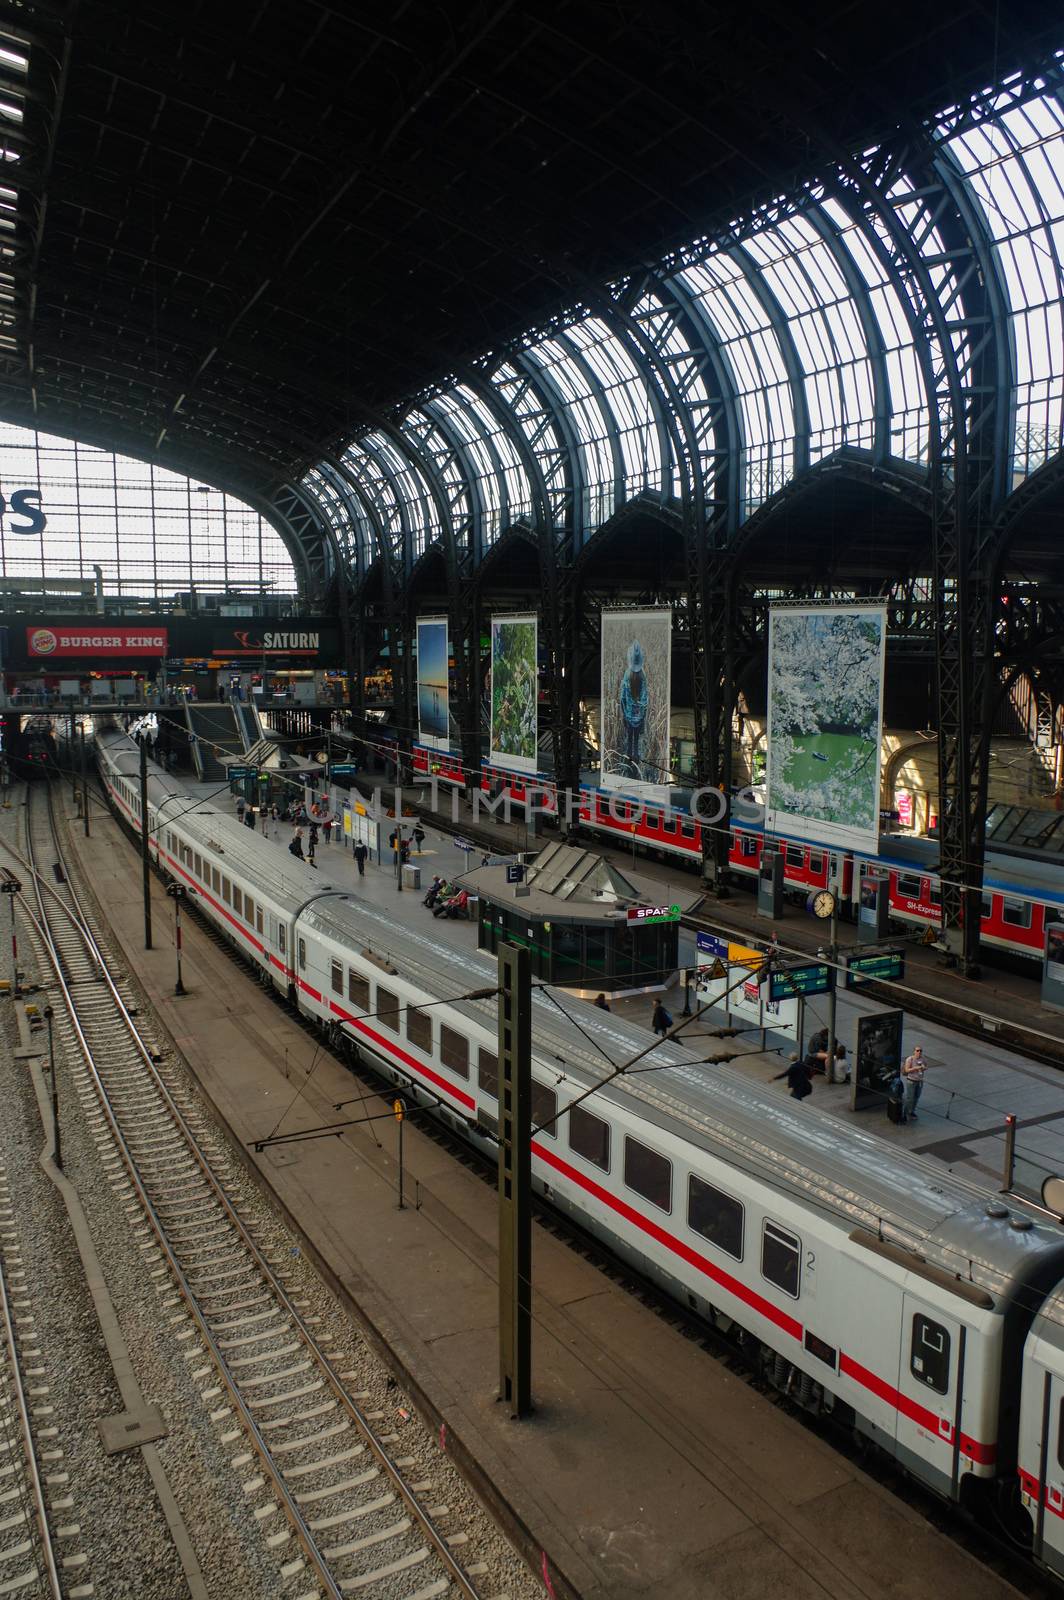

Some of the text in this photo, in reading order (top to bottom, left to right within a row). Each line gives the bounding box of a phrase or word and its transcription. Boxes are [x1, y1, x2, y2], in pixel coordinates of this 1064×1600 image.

[60, 637, 164, 647] BURGER KING
[264, 632, 319, 649] SATURN
[510, 866, 518, 880] E
[922, 879, 928, 889] 2
[807, 1251, 816, 1271] 2
